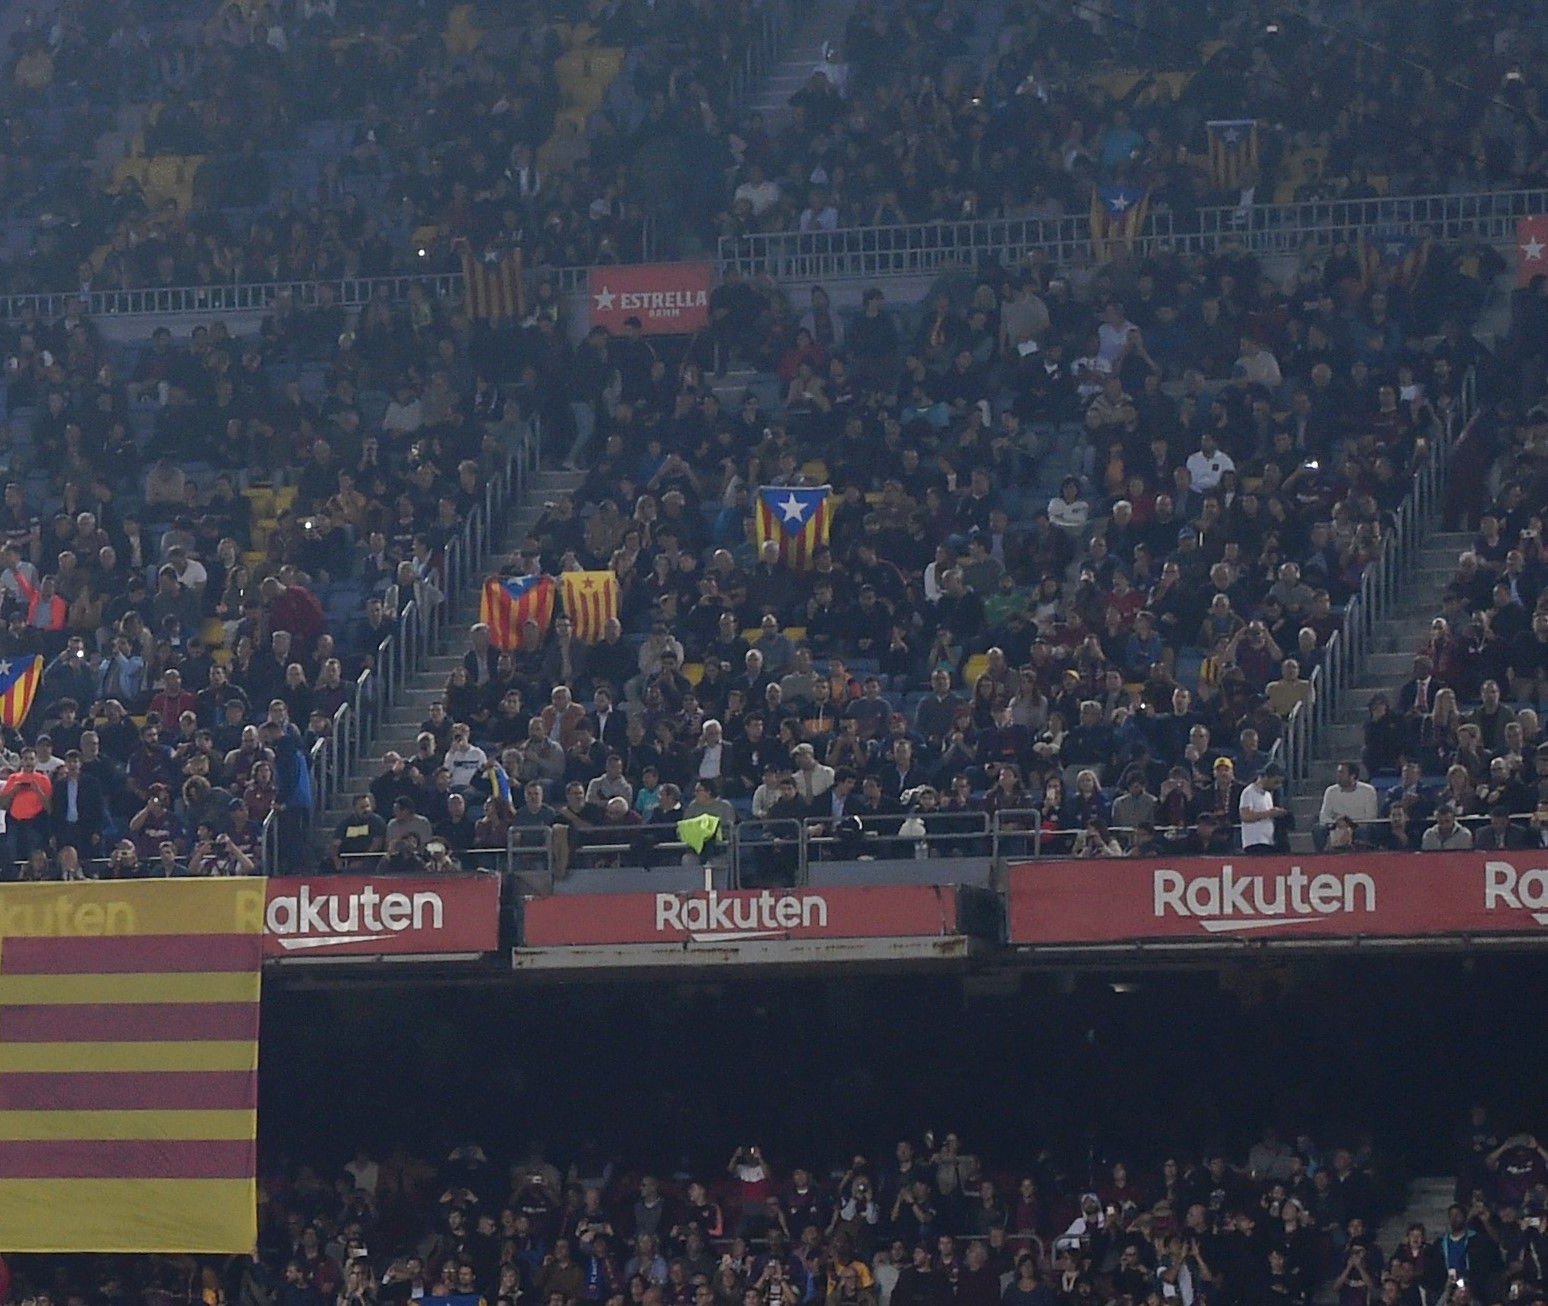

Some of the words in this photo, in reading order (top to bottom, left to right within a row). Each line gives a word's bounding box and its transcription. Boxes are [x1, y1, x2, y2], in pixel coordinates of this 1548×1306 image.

[621, 291, 707, 309] ESTRELLA
[656, 889, 827, 931] Rakuten
[1154, 865, 1375, 916] Rakuten
